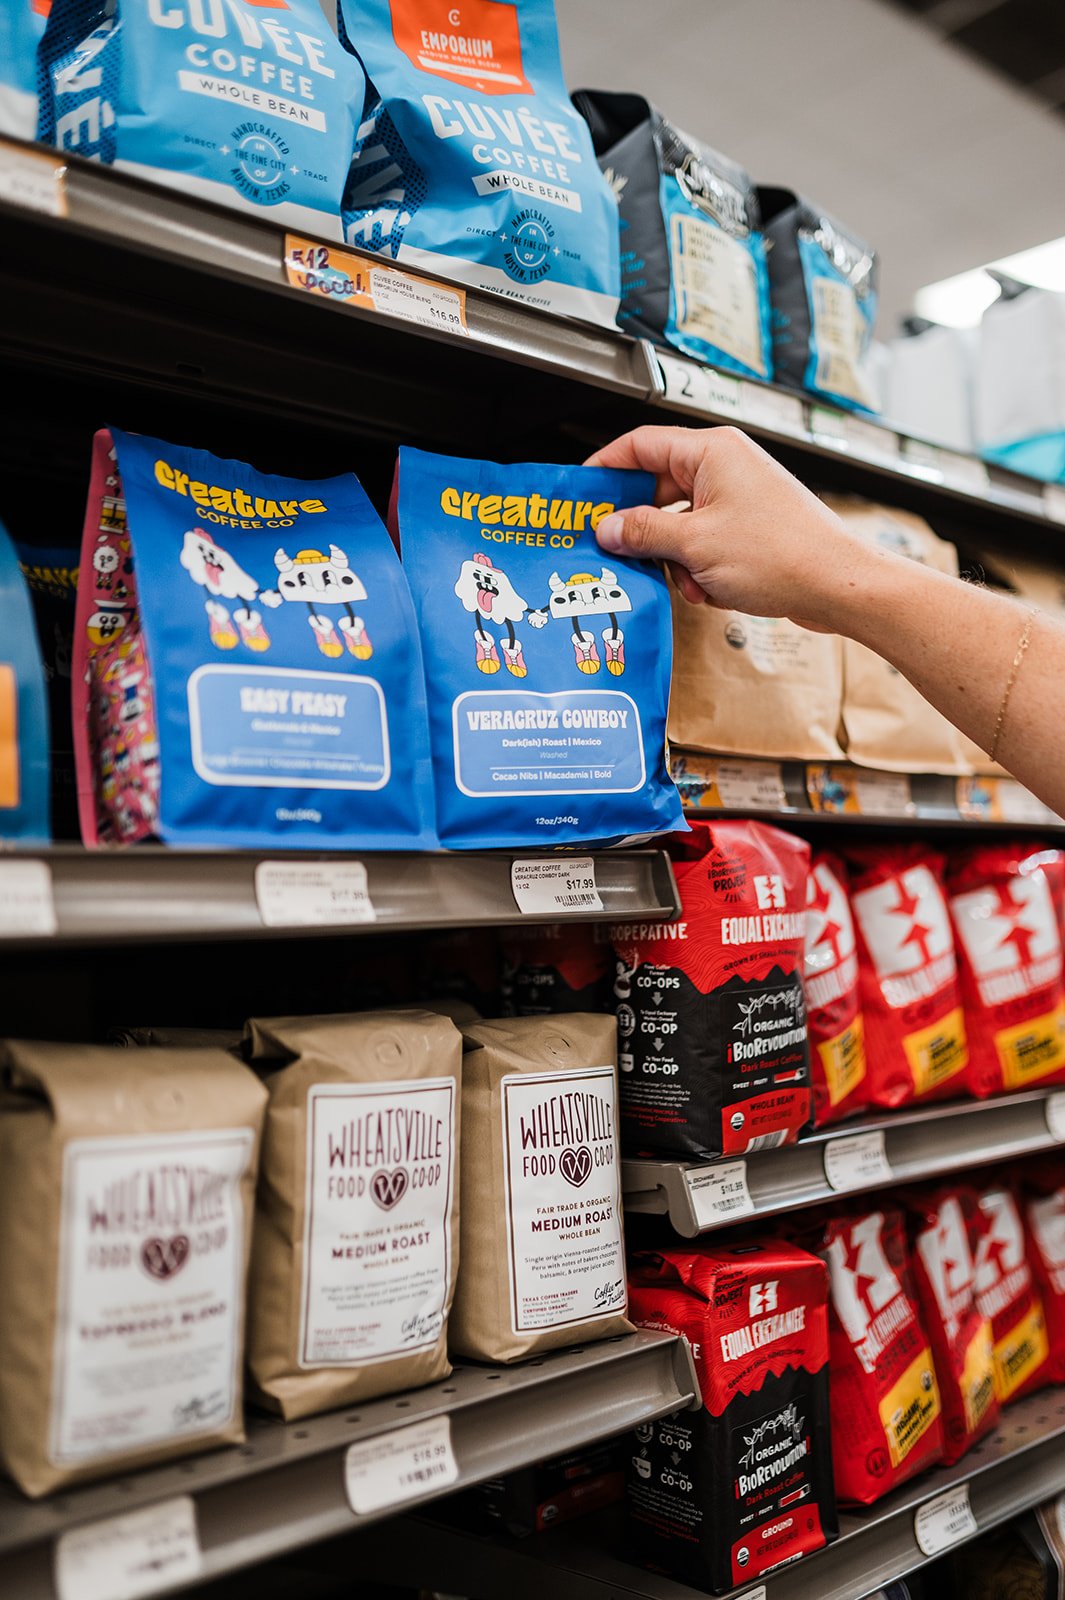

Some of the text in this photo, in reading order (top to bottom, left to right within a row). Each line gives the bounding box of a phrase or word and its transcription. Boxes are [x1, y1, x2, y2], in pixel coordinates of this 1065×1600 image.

[421, 31, 493, 58] EMPORIUM
[186, 43, 315, 100] COFFEE
[200, 79, 309, 121] WHOLE BEAN
[422, 94, 582, 163] CUVÉE
[184, 135, 216, 149] DIRECT
[230, 122, 290, 155] HANDCRAFTED
[235, 149, 286, 171] THE FINE CITY
[472, 144, 571, 183] COFFEE
[304, 169, 328, 182] TRADE
[265, 181, 291, 200] TEXAS
[487, 174, 569, 203] WHOLE BEAN
[466, 226, 497, 238] DIRECT
[511, 208, 555, 238] HANDCRAFTED
[511, 235, 551, 253] THE FINE CITY
[292, 246, 330, 270] 512
[529, 262, 551, 280] TEXAS
[392, 280, 413, 291] COFFEE
[480, 284, 551, 306] WHOLE BEAN COFFEE
[430, 307, 460, 325] $16.99
[678, 367, 695, 398] 2
[195, 507, 264, 529] COFFEE
[480, 528, 546, 547] COFFEE
[240, 686, 347, 718] EASY PEASY
[467, 709, 628, 731] VERACRUZ COWBOY
[502, 737, 602, 748] Dark(ish) Roast Mexico
[540, 751, 568, 759] Washed
[492, 770, 612, 781] Cacao Nibs Macadamia Bold
[535, 816, 579, 825] 12oz/340g
[541, 864, 561, 872] COFFEE
[566, 878, 594, 890] $17.99
[721, 917, 764, 946] EQUAL
[723, 957, 748, 971] GROWN
[637, 976, 680, 989] CO-OPS
[656, 1010, 678, 1018] Exchange
[641, 1022, 678, 1035] CO-OP
[753, 1016, 794, 1033] ORGANIC
[642, 1062, 679, 1075] CO-OP
[741, 1062, 757, 1073] Dark
[732, 1081, 749, 1090] SWEET
[750, 1094, 795, 1111] WHOLE BEAN
[520, 1092, 612, 1150] WHEATSVILLE
[327, 1107, 443, 1168] WHEATSVILLE
[523, 1154, 557, 1177] FOOD
[328, 1175, 366, 1201] FOOD
[537, 1206, 555, 1214] FAIR
[557, 1202, 578, 1213] TRADE
[586, 1195, 611, 1207] ORGANIC
[531, 1206, 613, 1232] MEDIUM ROAST
[559, 1227, 601, 1241] WHOLE BEAN
[332, 1231, 431, 1259] MEDIUM ROAST
[524, 1256, 544, 1264] Single
[546, 1253, 563, 1261] origin
[547, 1262, 560, 1270] with
[583, 1255, 599, 1263] bakers
[540, 1271, 568, 1279] balsamic,
[572, 1265, 590, 1273] orange
[590, 1263, 601, 1271] juice
[559, 1289, 578, 1297] TRADERS
[594, 1281, 615, 1301] Coffee
[662, 1323, 680, 1336] Chain
[720, 1325, 755, 1362] EQUAL
[727, 1370, 746, 1389] GROWN
[659, 1433, 693, 1452] CO-OP
[755, 1436, 793, 1462] ORGANIC
[660, 1472, 693, 1492] CO-OP
[746, 1471, 806, 1507] Dark Roast Coffee
[740, 1504, 774, 1525] SWEET FRUITY
[762, 1518, 794, 1539] GROUND
